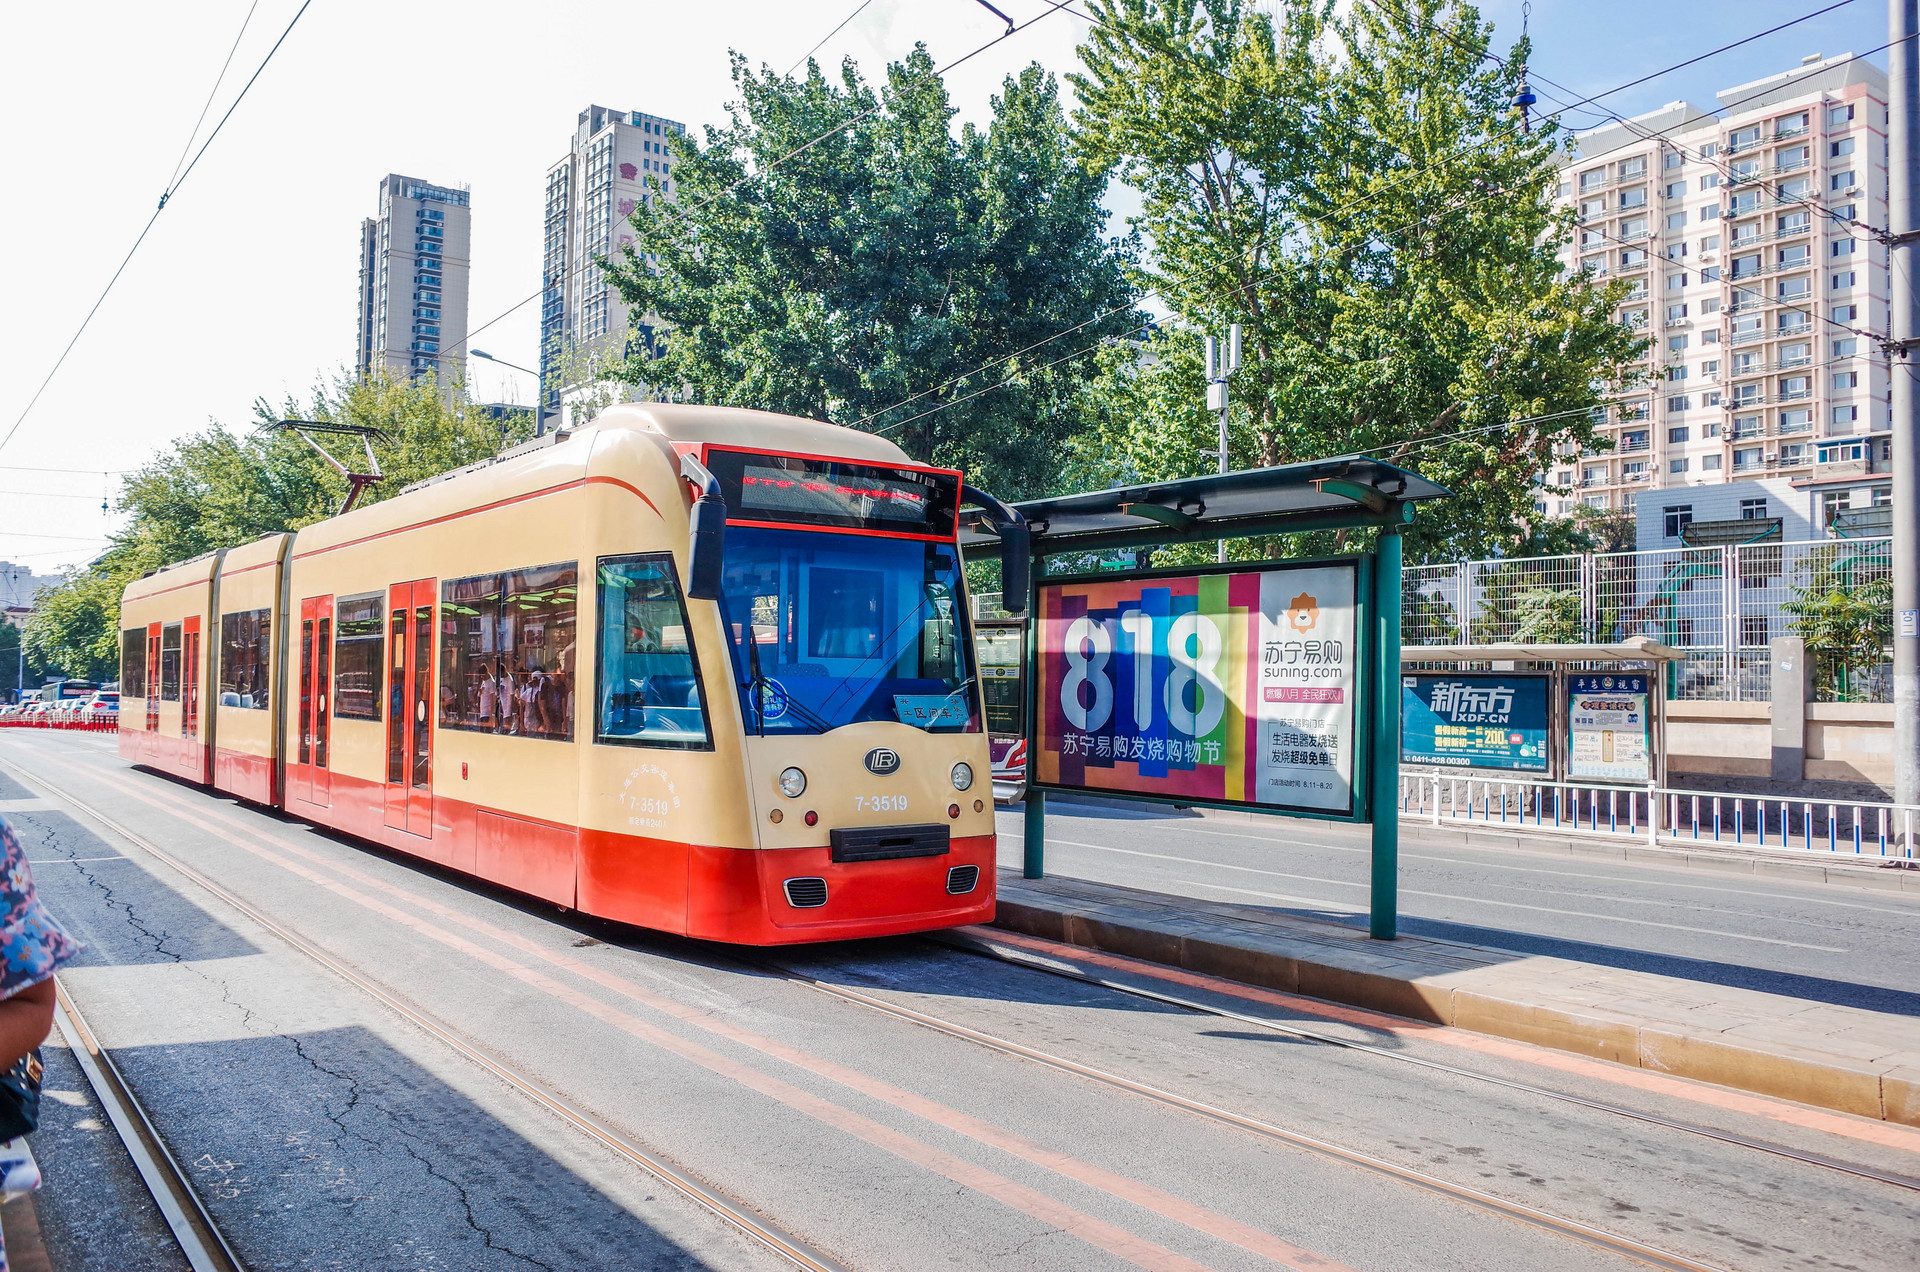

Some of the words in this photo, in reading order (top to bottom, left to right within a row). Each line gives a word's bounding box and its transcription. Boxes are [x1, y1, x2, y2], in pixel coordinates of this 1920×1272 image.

[1265, 640, 1342, 664] 苏宁易购
[1060, 609, 1225, 738] 818
[1264, 667, 1342, 681] suning.com
[1429, 681, 1515, 721] 新东方
[1280, 719, 1325, 728] 苏宁易购门店
[1457, 713, 1509, 723] XDF.CN
[1063, 732, 1221, 765] 苏宁易购发烧购物节
[1272, 732, 1338, 748] 生活电器发烧送
[1271, 749, 1338, 766] 发烧超级免单日
[1268, 778, 1301, 787] 门店活动时间
[1303, 781, 1333, 790] 8.11-8.20
[630, 796, 668, 815] 7-3519
[855, 795, 908, 812] 7-3519
